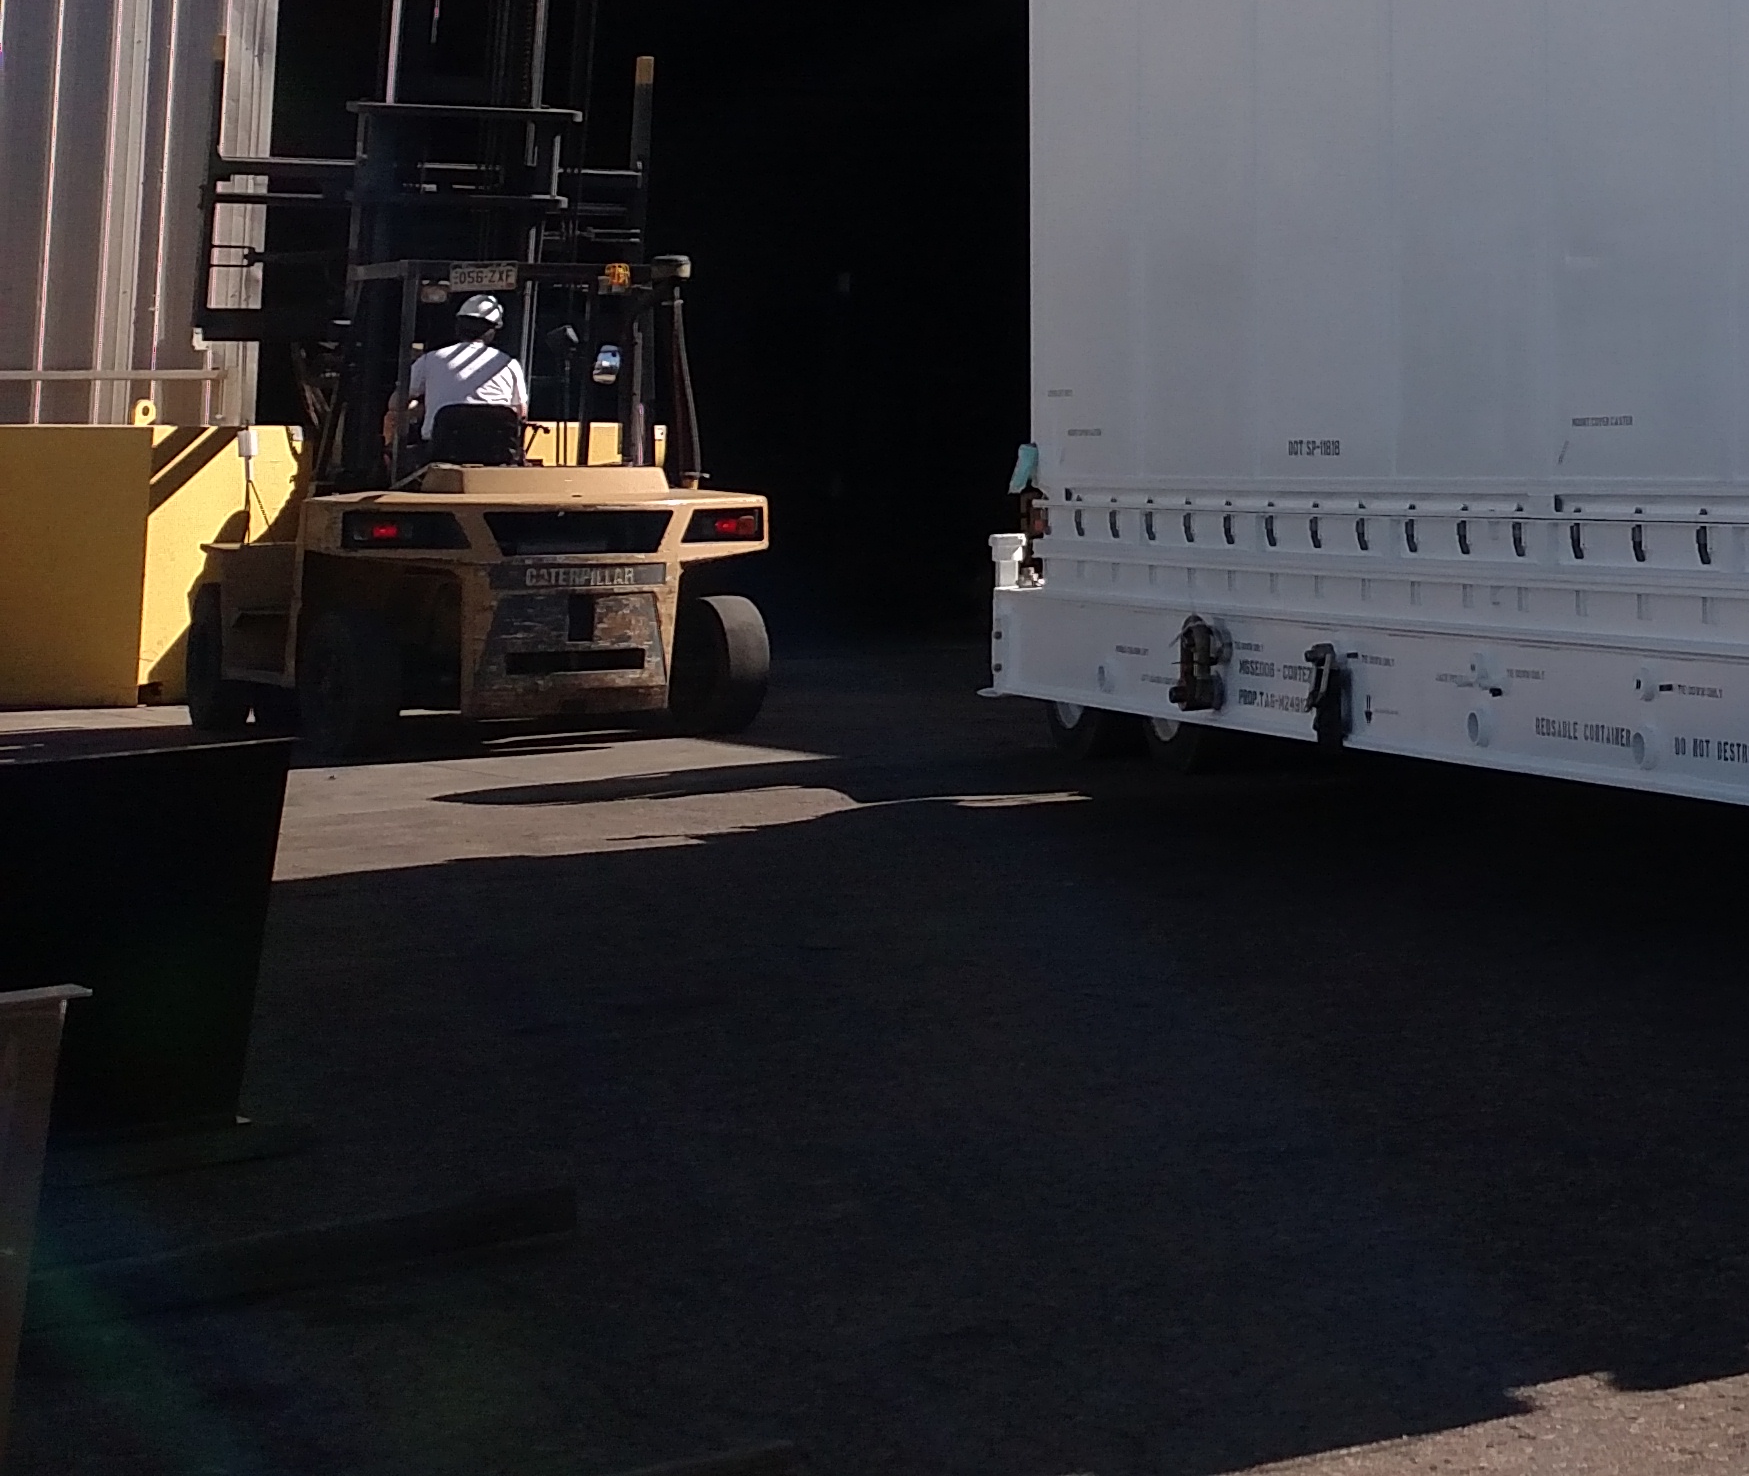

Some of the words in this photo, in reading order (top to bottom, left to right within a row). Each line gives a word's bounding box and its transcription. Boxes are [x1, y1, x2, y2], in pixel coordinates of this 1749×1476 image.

[525, 567, 635, 586] CATERPILLAR
[1535, 717, 1579, 740] REUSABLE
[1583, 723, 1631, 747] CONTAINER
[1693, 738, 1710, 758] NOT
